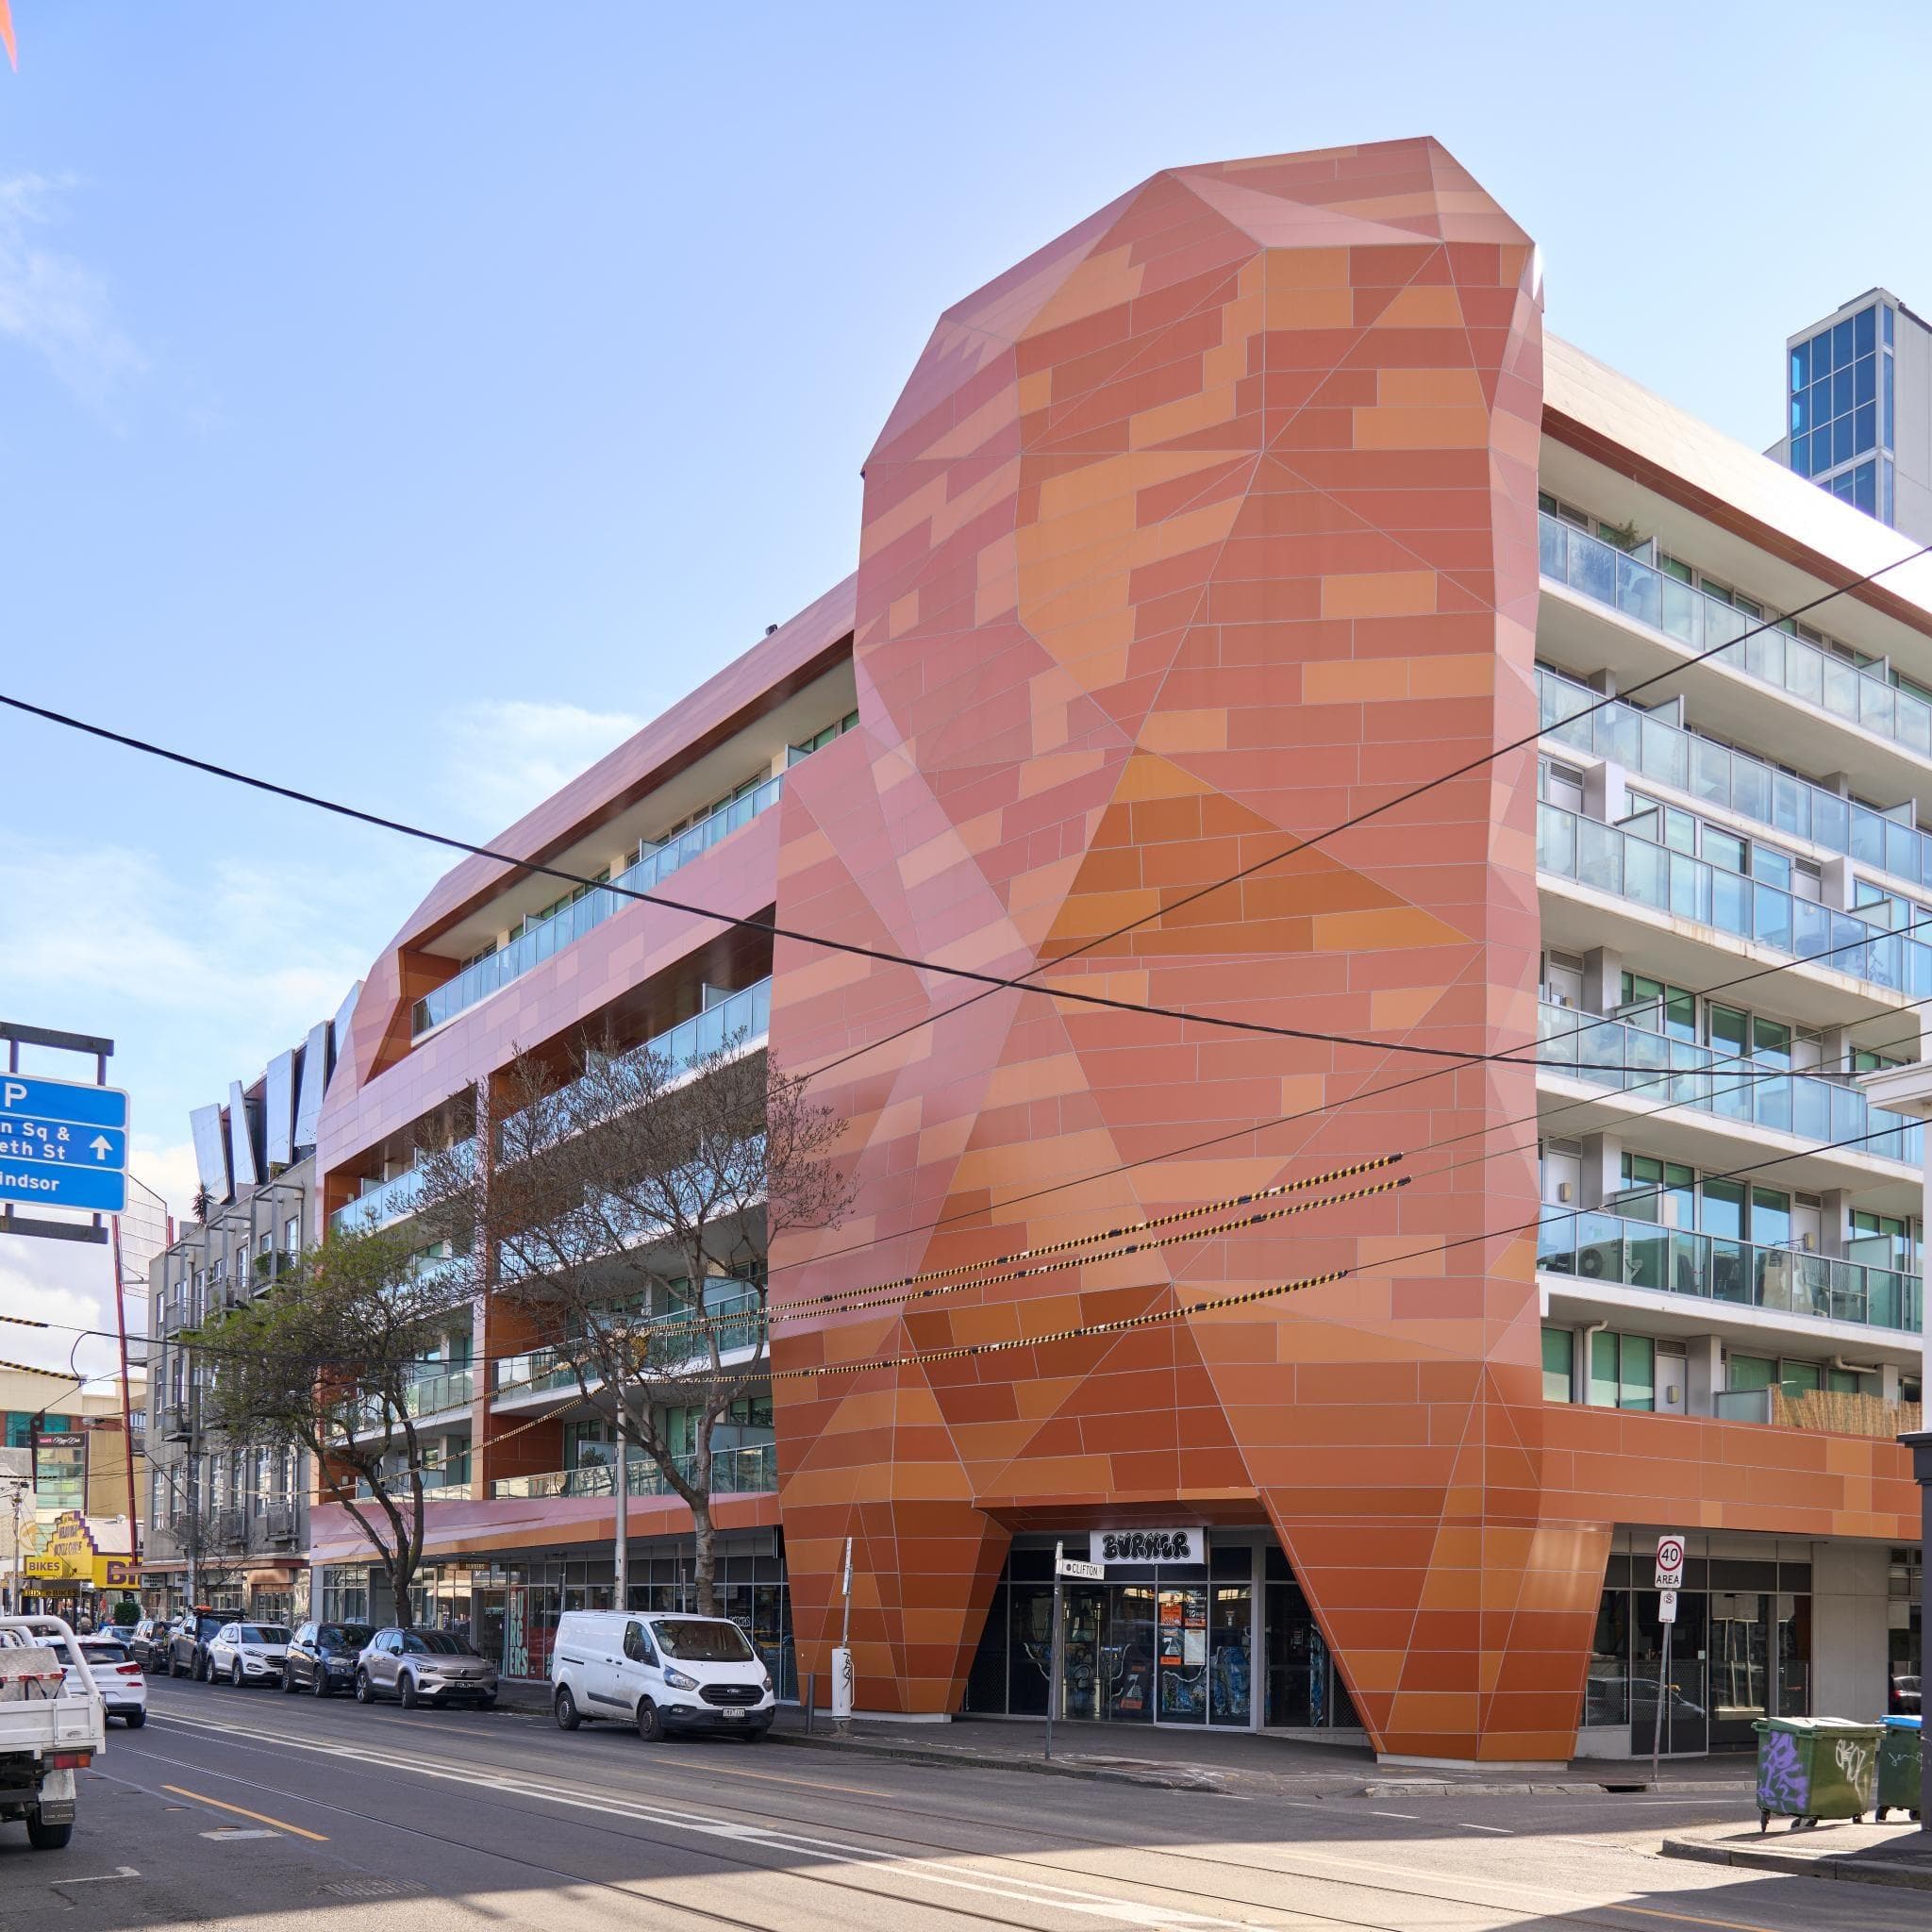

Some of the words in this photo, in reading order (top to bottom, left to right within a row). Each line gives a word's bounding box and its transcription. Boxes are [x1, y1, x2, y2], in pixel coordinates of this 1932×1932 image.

[5, 1082, 27, 1108] P
[23, 1122, 48, 1141] Sq
[57, 1126, 71, 1141] &
[42, 1143, 66, 1160] St
[1102, 1531, 1191, 1560] BURNER
[1661, 1548, 1678, 1562] 40
[29, 1561, 60, 1572] BIKES
[1072, 1562, 1098, 1576] CLIFTON
[1656, 1574, 1680, 1585] AREA
[509, 1646, 528, 1676] ERS
